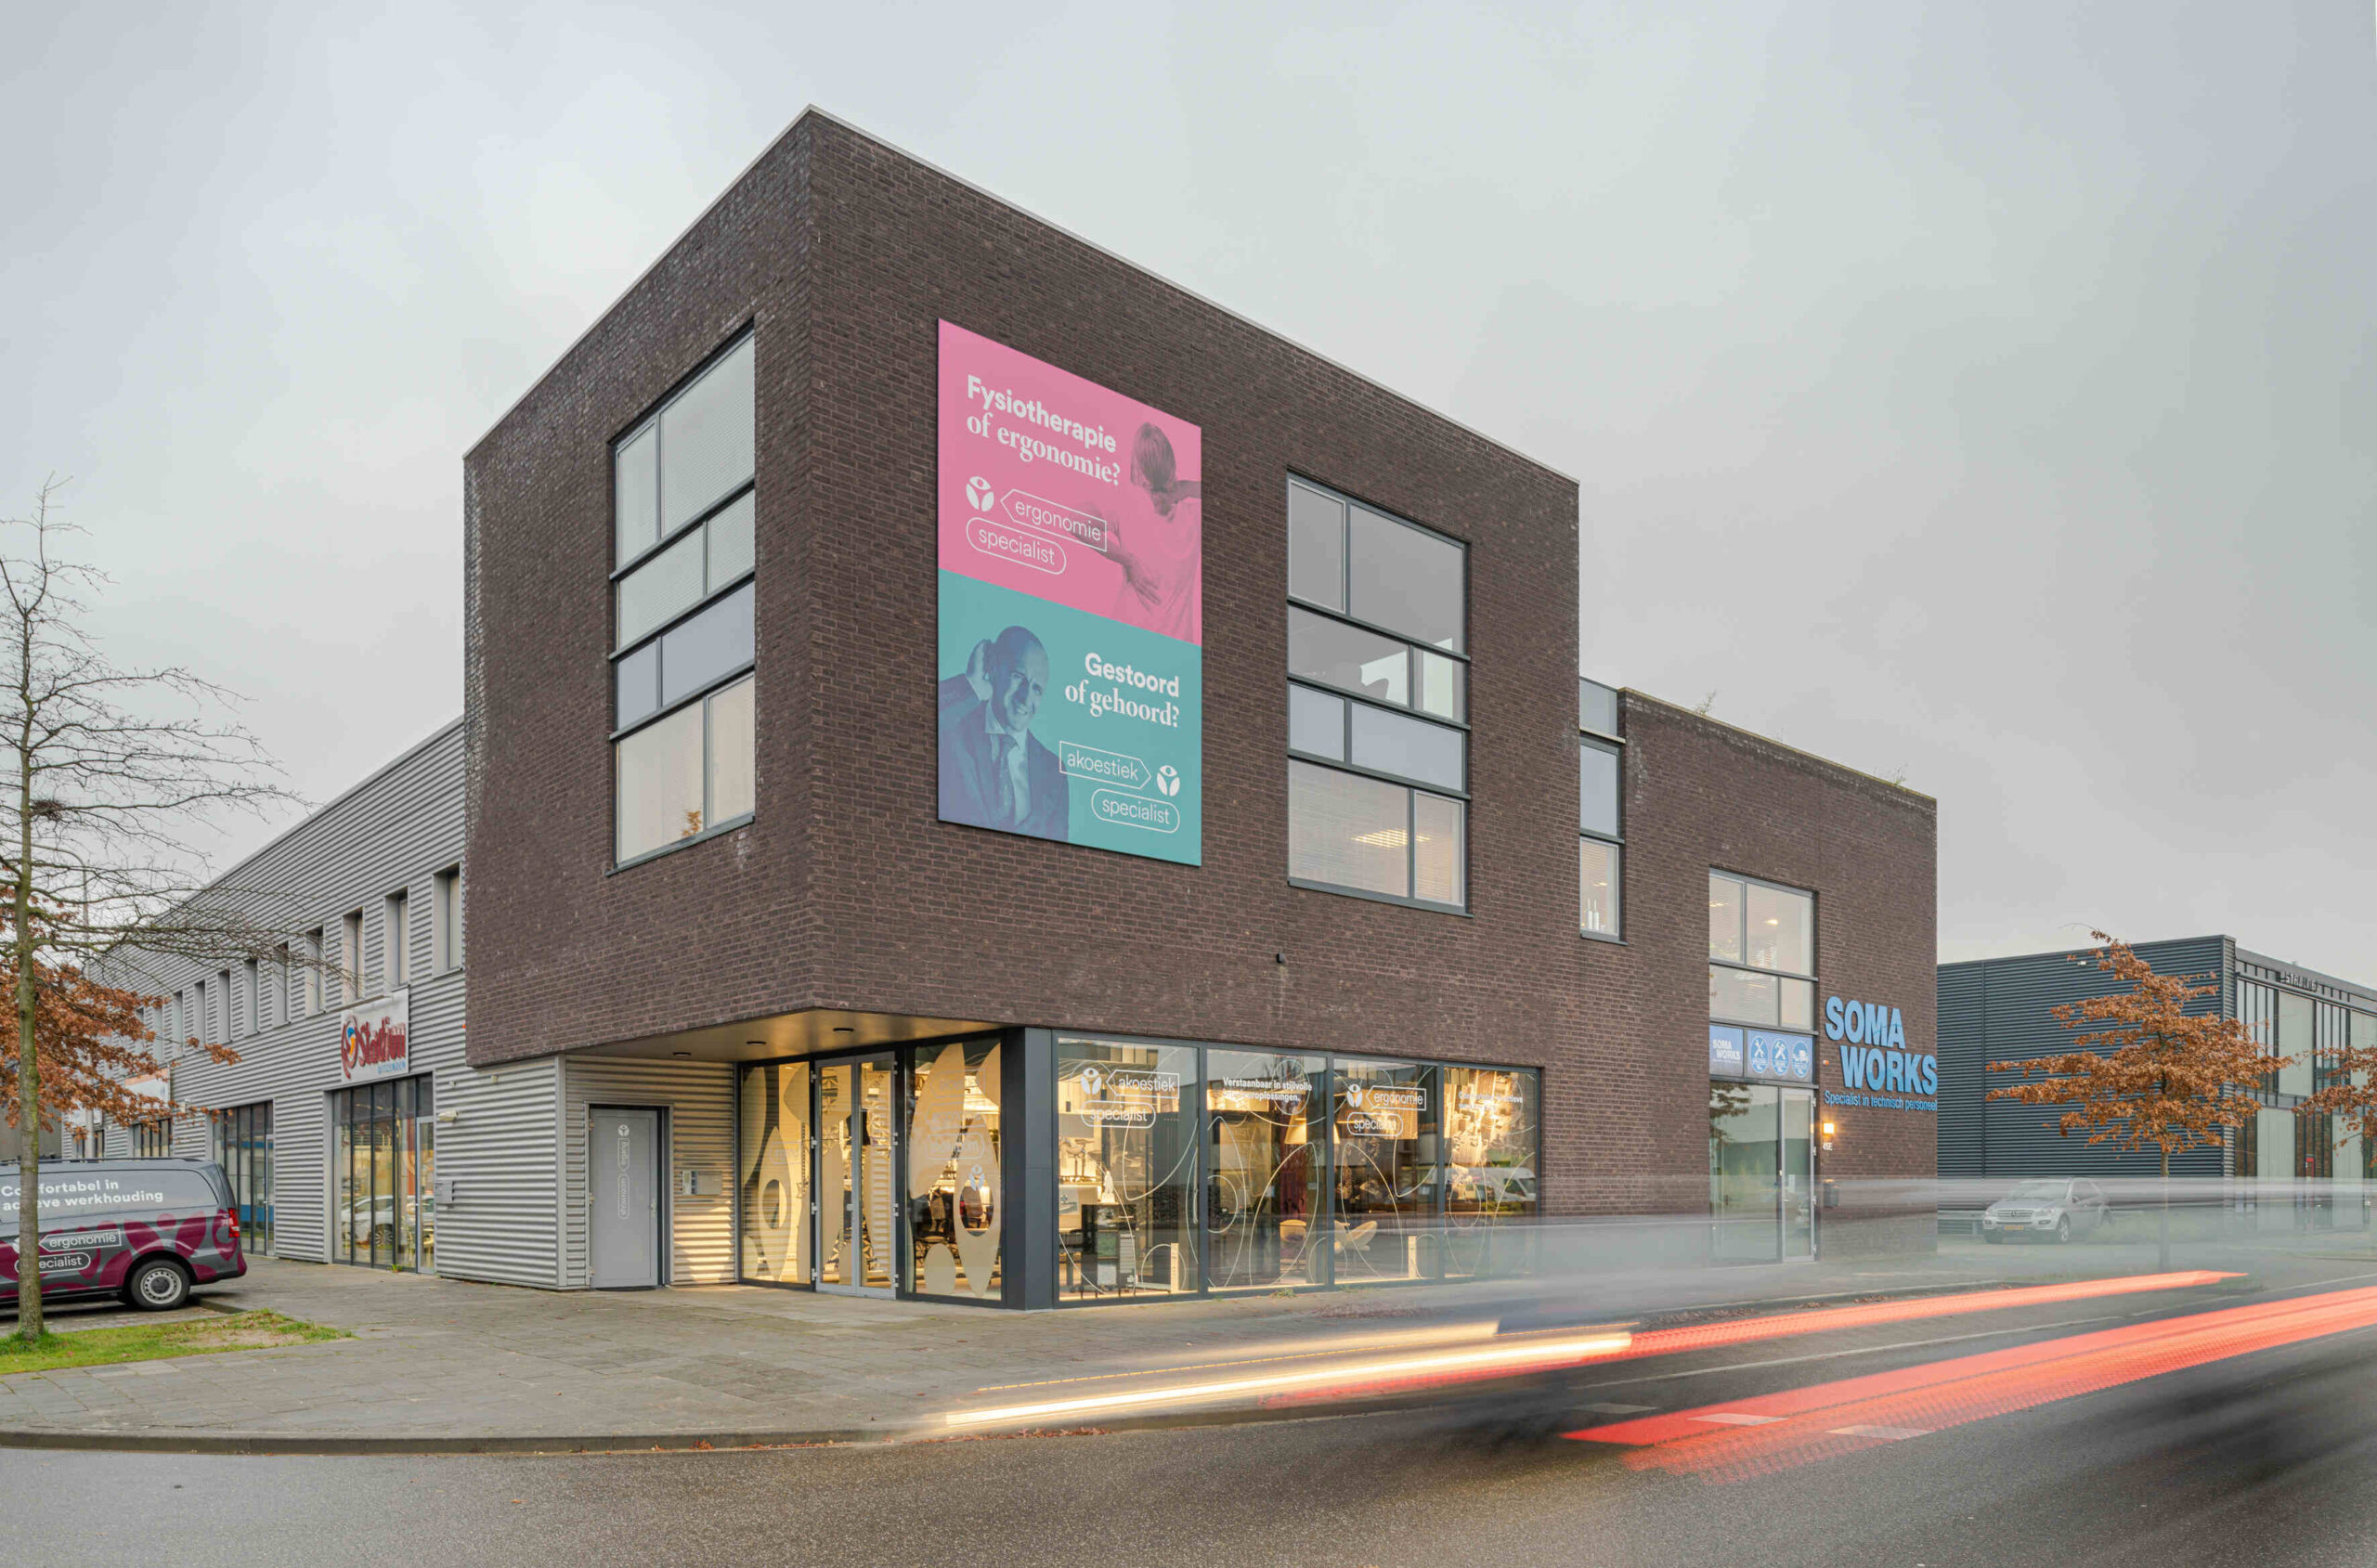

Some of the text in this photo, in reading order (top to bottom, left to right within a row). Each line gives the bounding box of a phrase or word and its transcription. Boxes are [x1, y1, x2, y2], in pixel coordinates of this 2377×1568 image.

[968, 374, 1116, 453] Fysiotherapie
[967, 412, 1121, 486] of ergonomie?
[1015, 499, 1101, 541] ergonomie
[979, 528, 1056, 565] specialist
[1085, 653, 1179, 698] Gestoord
[1065, 680, 1179, 728] of gehoord?
[1067, 750, 1139, 781] akoestiek
[1102, 797, 1171, 824] specialist
[1825, 996, 1906, 1049] SOMA
[1712, 1039, 1732, 1050] SOMA
[1716, 1049, 1741, 1060] WORKS
[1840, 1045, 1938, 1095] WORKS
[1119, 1074, 1176, 1093] akoestiek
[1223, 1077, 1272, 1088] Verstaanbaar
[1274, 1080, 1281, 1089] in
[1374, 1091, 1423, 1106] ergonomie
[1825, 1090, 1938, 1112] Specialist in technisch personeel
[1090, 1105, 1148, 1122] specialist
[1354, 1115, 1397, 1132] speciast
[1, 1179, 119, 1197] Cofortabel in
[3, 1189, 163, 1211] aceve werkhouding
[49, 1233, 117, 1249] ergonomie
[38, 1256, 82, 1269] ecialist
